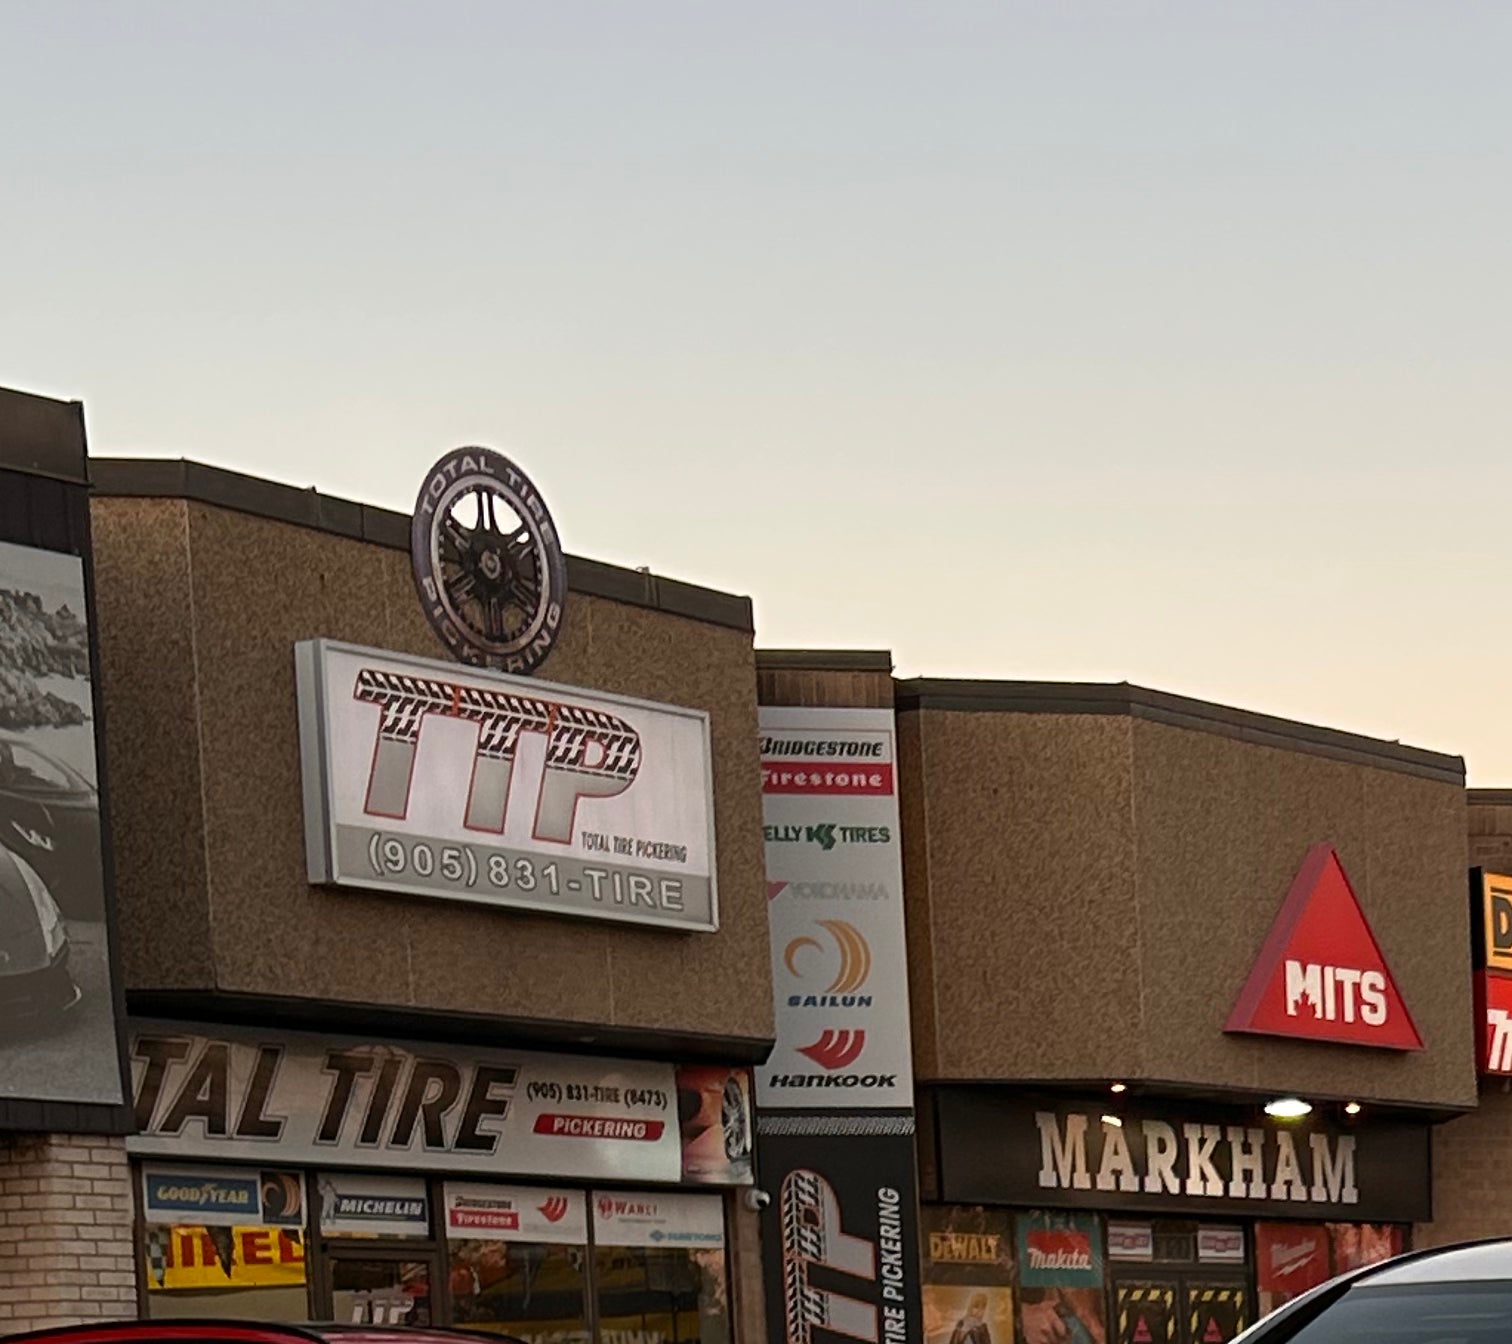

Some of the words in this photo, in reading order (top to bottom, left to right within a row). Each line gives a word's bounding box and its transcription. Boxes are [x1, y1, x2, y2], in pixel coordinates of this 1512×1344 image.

[421, 455, 494, 515] TOTAL
[506, 468, 553, 546] TIRE
[422, 576, 560, 673] PICKERING
[354, 669, 642, 845] TTP
[760, 737, 883, 757] BRIDGESTONE
[581, 831, 610, 852] TOTAL
[613, 837, 634, 855] TIRE
[636, 841, 688, 863] PICKERING
[762, 825, 802, 842] ELLY
[840, 826, 890, 843] TIRES
[368, 832, 479, 887] (905)
[488, 854, 685, 912] 831-TIRE
[788, 995, 872, 1007] SAILUN
[1285, 960, 1388, 1027] MITS
[313, 1049, 520, 1155] TIRE
[527, 1081, 562, 1104] (905)
[566, 1084, 621, 1103] 831-TIRE
[624, 1088, 667, 1110] (8473)
[553, 1116, 647, 1138] PICKERING
[1035, 1111, 1359, 1203] MARKHAM
[157, 1183, 249, 1205] GOODYEAR
[340, 1199, 423, 1216] MICHELIN
[455, 1213, 513, 1227] Firestone
[878, 1187, 904, 1300] PICKERING
